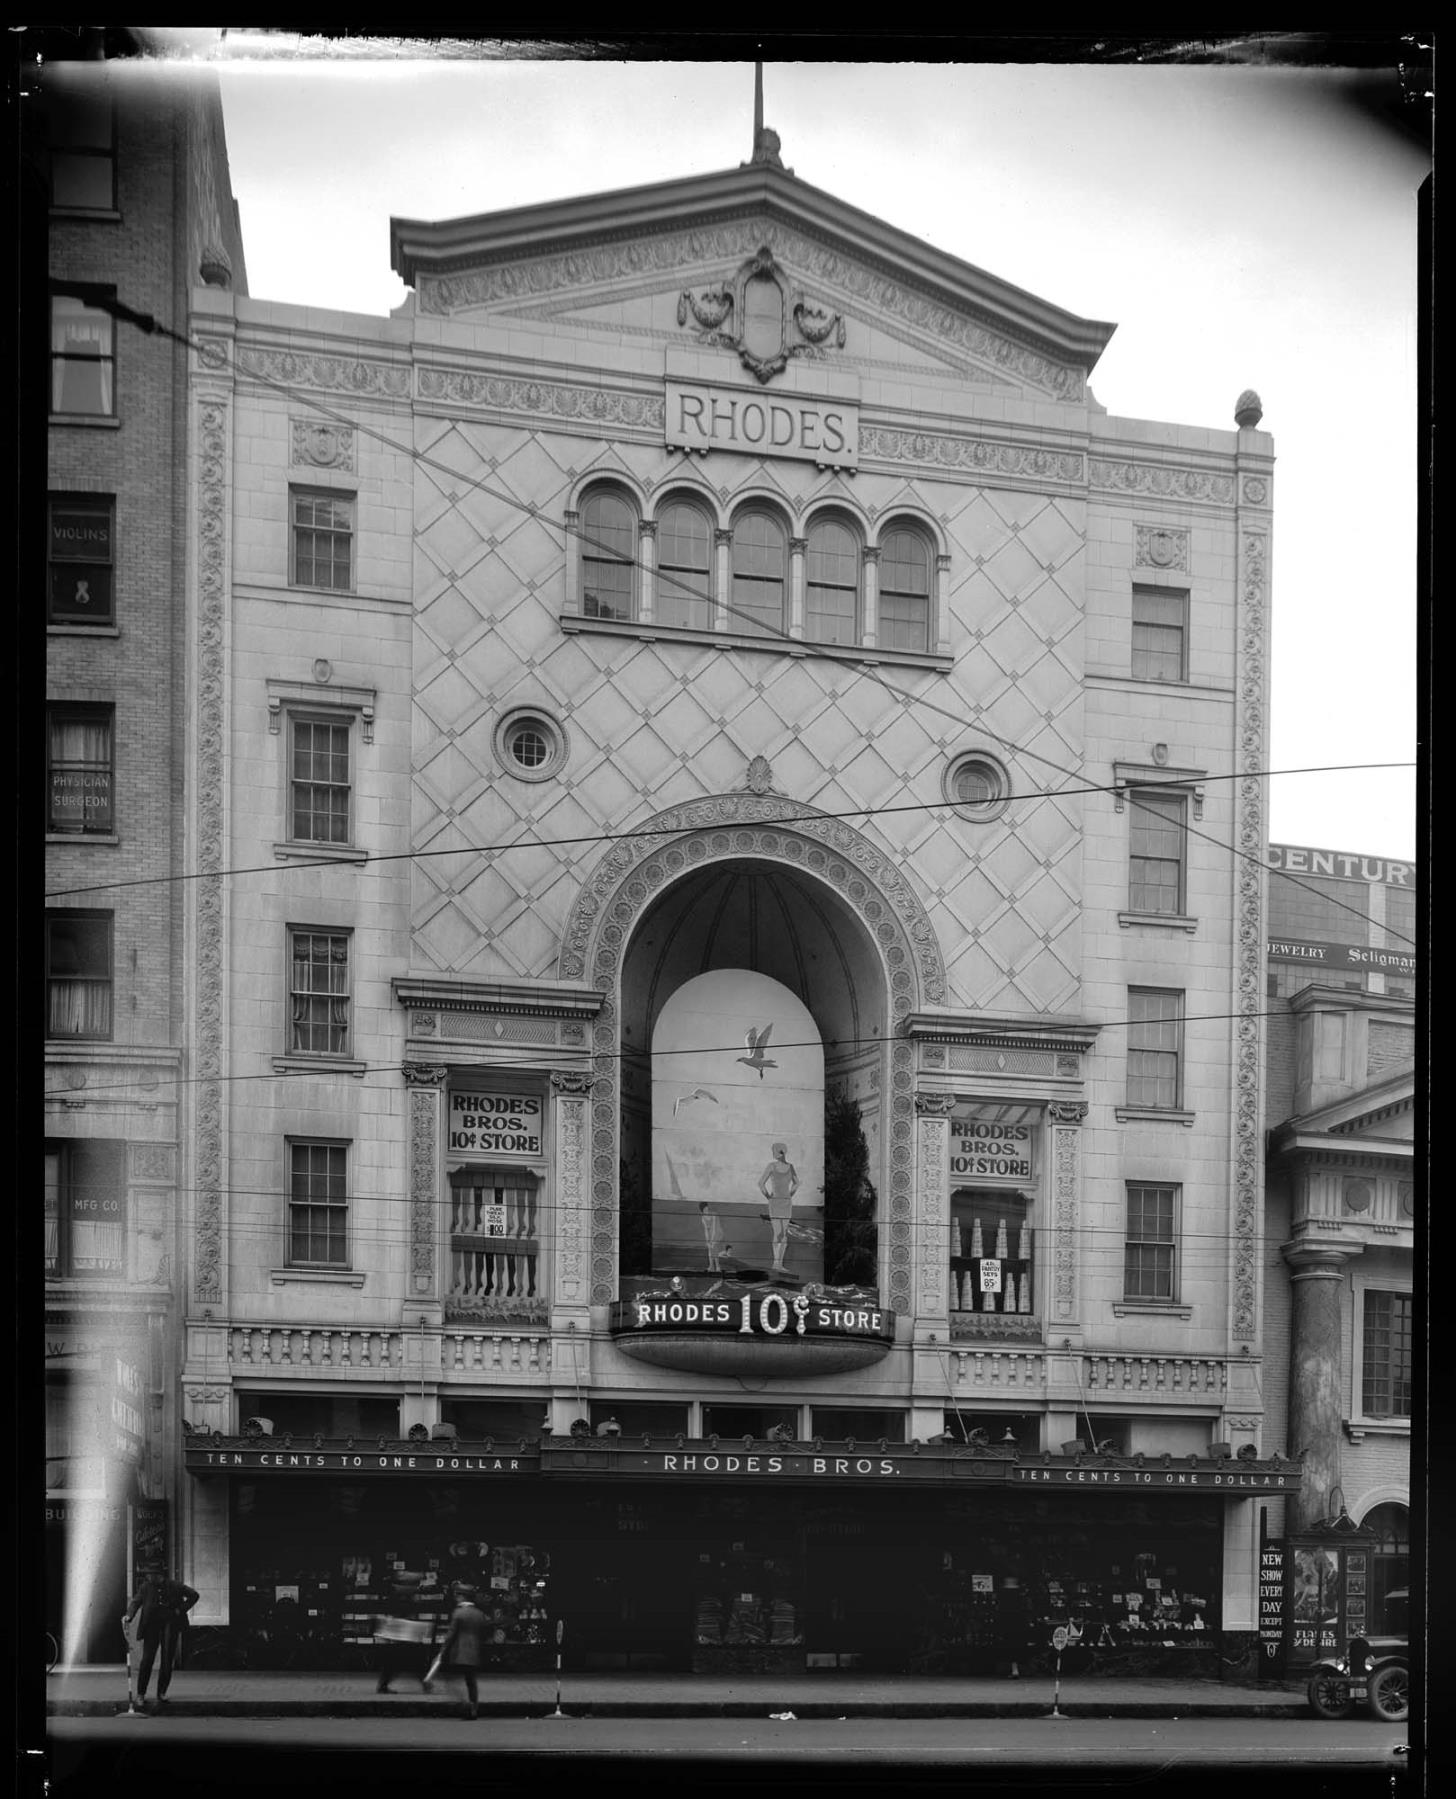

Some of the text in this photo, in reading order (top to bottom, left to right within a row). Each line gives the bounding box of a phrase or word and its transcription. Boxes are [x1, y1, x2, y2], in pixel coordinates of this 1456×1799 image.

[53, 527, 108, 541] VIOLINS
[53, 776, 108, 788] PHYSICIAN
[54, 795, 108, 807] SURGEON
[1268, 847, 1416, 885] CENTUR
[453, 1095, 539, 1115] RHODES
[462, 1114, 528, 1131] BROS.
[951, 1121, 1029, 1140] RHODES
[451, 1131, 539, 1152] 10¢ STORE
[960, 1140, 1020, 1156] BROS.
[976, 1157, 1029, 1176] STORE
[74, 1199, 98, 1210] MFG
[638, 1293, 881, 1335] RHODES 10¢ STORE
[207, 1454, 520, 1469] TEN CENTS TO ONE DOLLAR
[664, 1455, 900, 1475] RHODES BROS.
[1020, 1470, 1285, 1486] TEN CENTS TO ONE DOLLAR
[1262, 1554, 1283, 1565] NEW
[1260, 1570, 1283, 1581] SHOW
[1260, 1586, 1283, 1597] EVERY
[1262, 1602, 1282, 1613] DAY
[1260, 1617, 1282, 1626] EXCEPT
[1259, 1630, 1283, 1638] MONDAY
